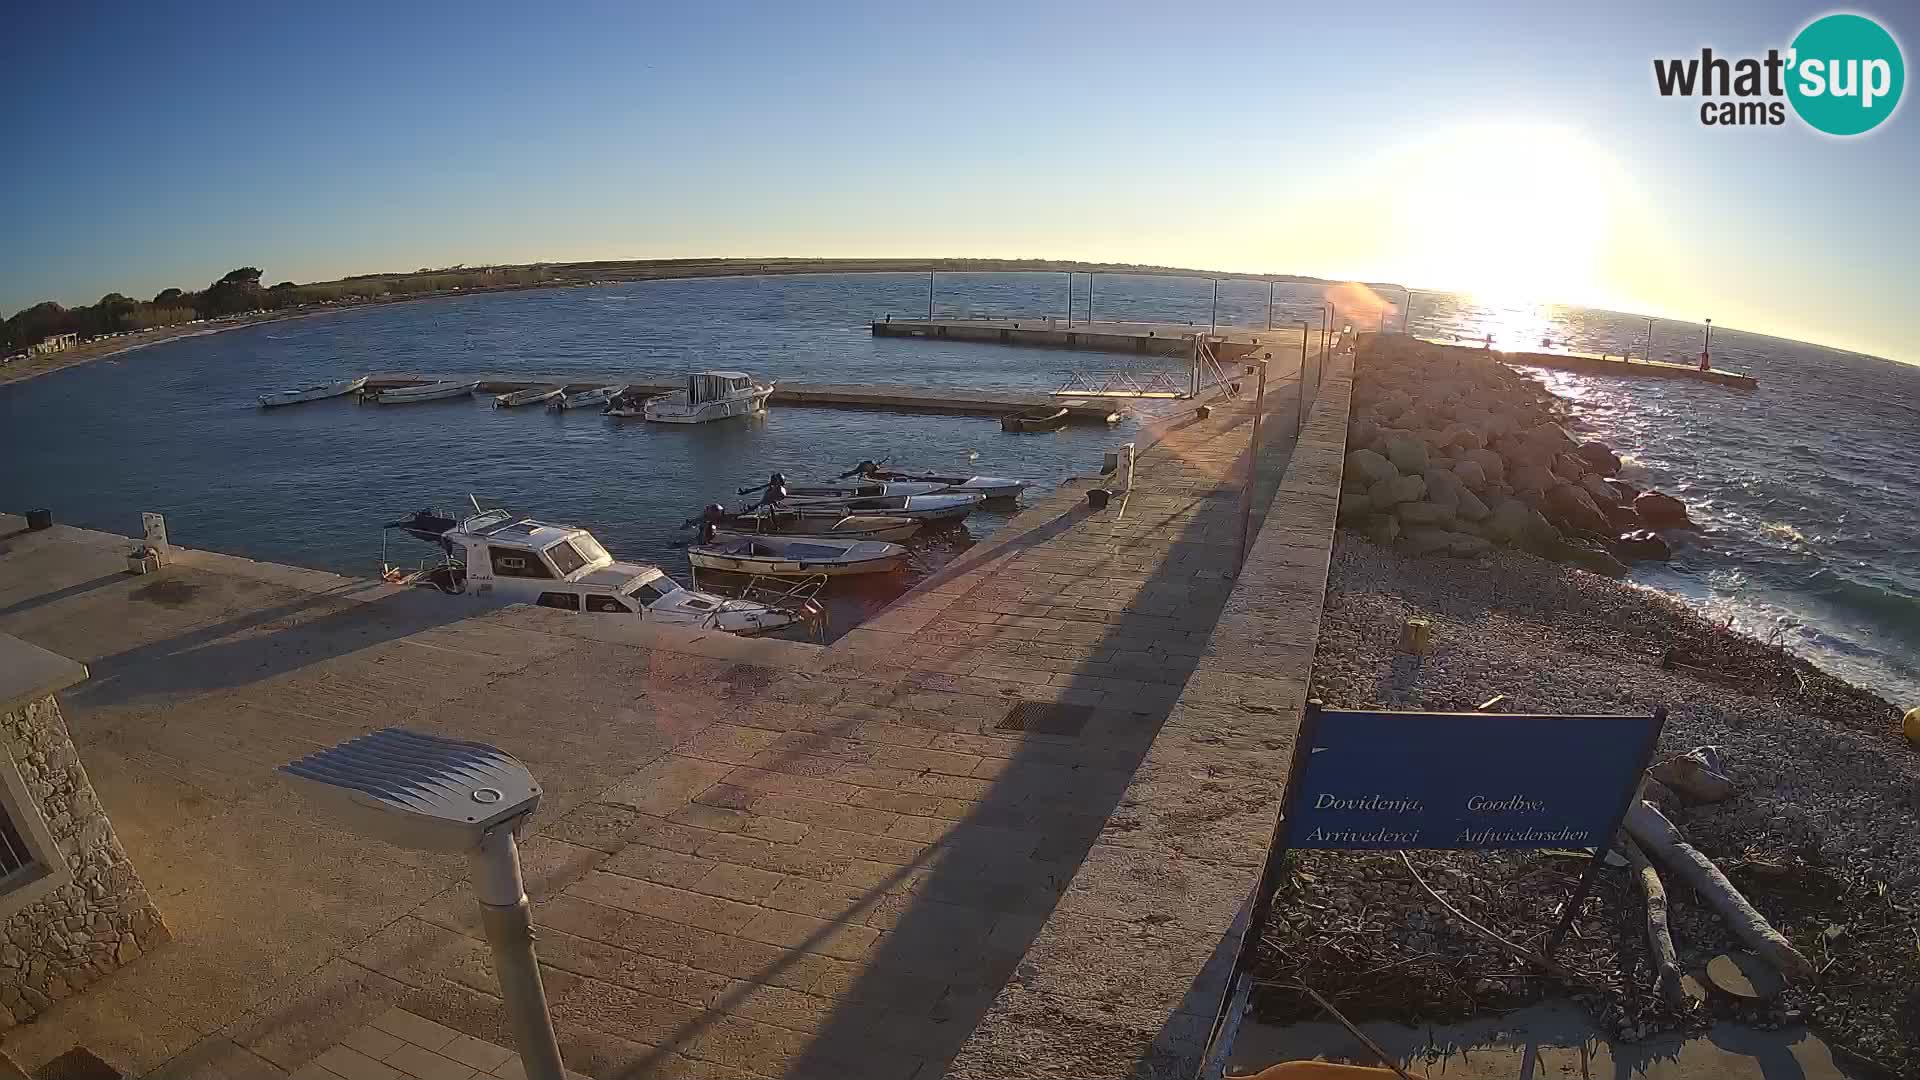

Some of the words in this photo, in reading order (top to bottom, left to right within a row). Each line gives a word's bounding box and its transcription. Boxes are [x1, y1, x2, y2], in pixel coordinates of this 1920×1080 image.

[1313, 793, 1425, 814] Dovidenja,
[1466, 794, 1546, 814] Goodbye,
[1305, 826, 1421, 843] Arrivederci
[1455, 826, 1590, 845] Aufwiedersehen
